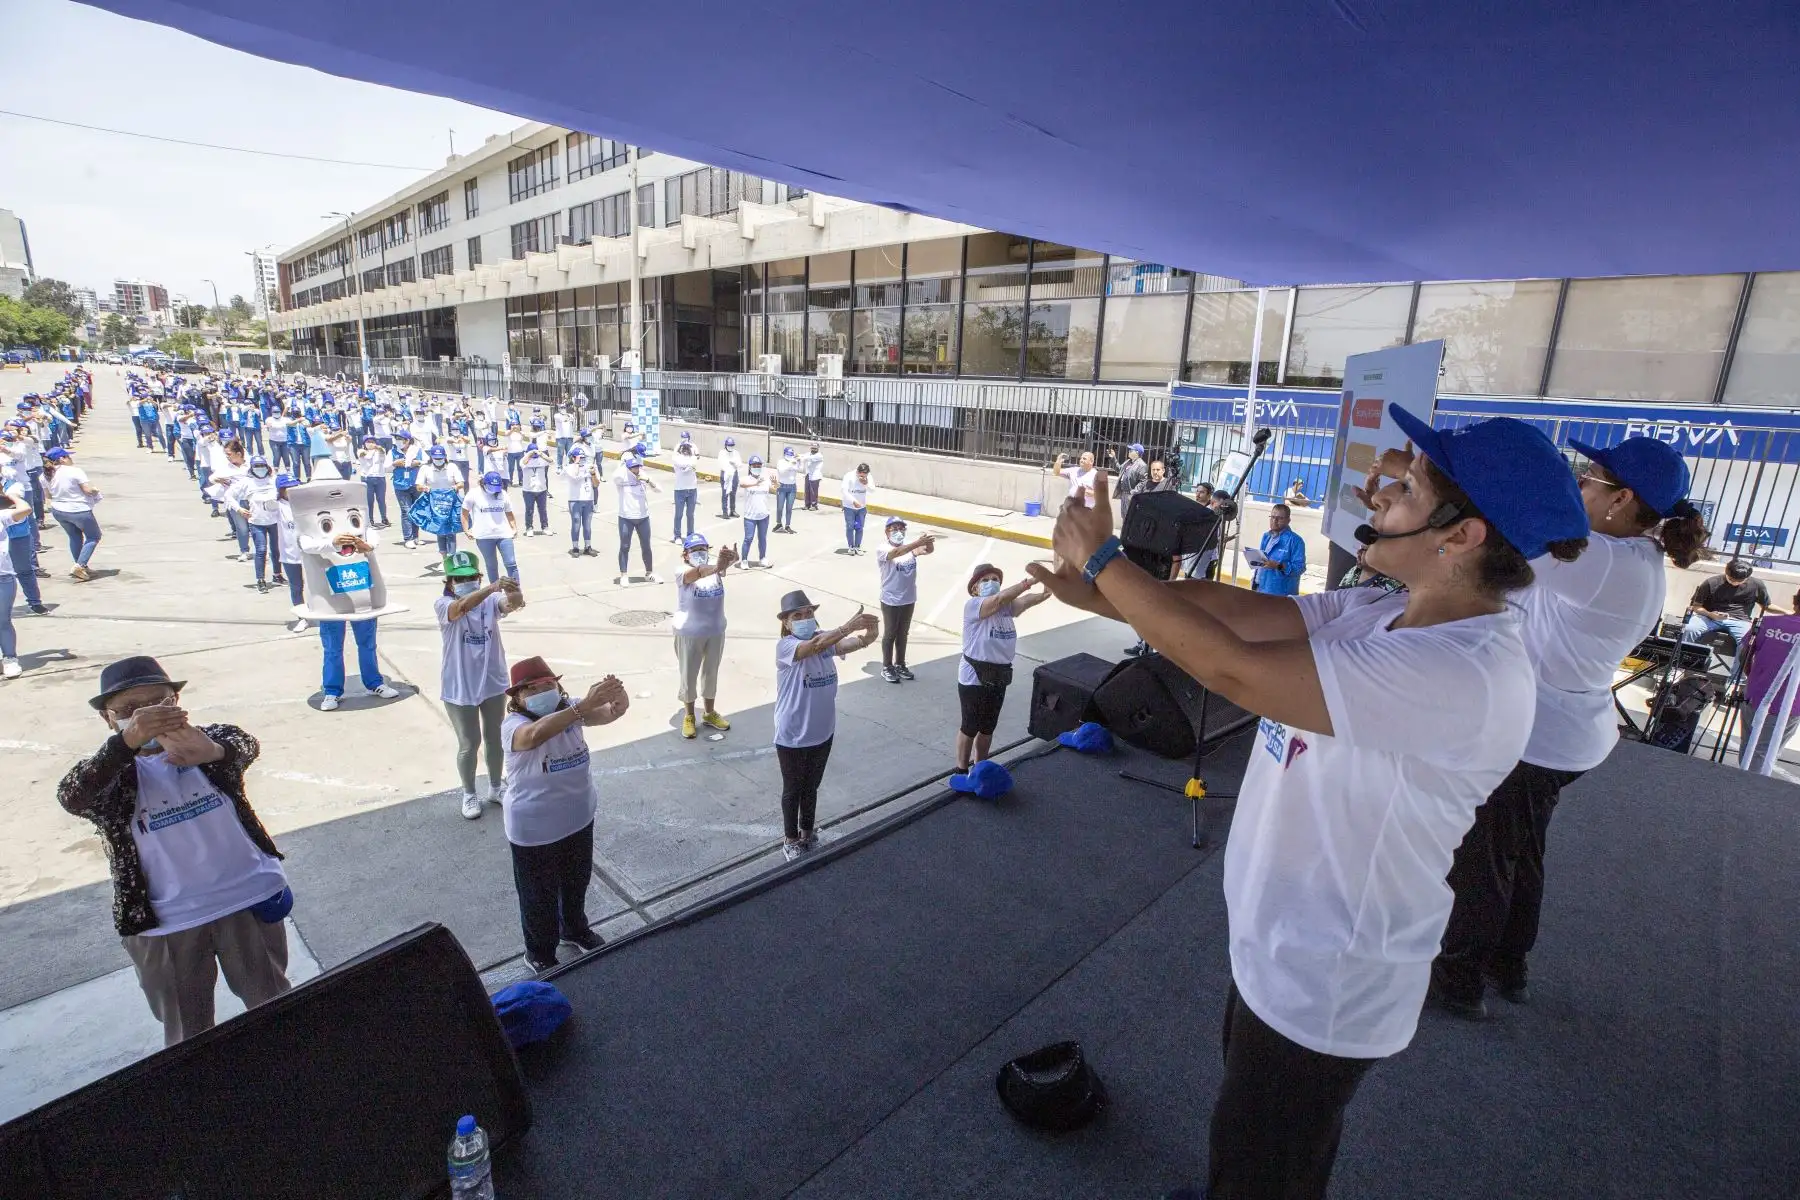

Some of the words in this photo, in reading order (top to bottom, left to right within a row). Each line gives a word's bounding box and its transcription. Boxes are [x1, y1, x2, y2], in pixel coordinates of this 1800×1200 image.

[1624, 417, 1740, 446] BBVA
[1734, 527, 1770, 538] BBVA
[336, 577, 366, 588] EsSalud
